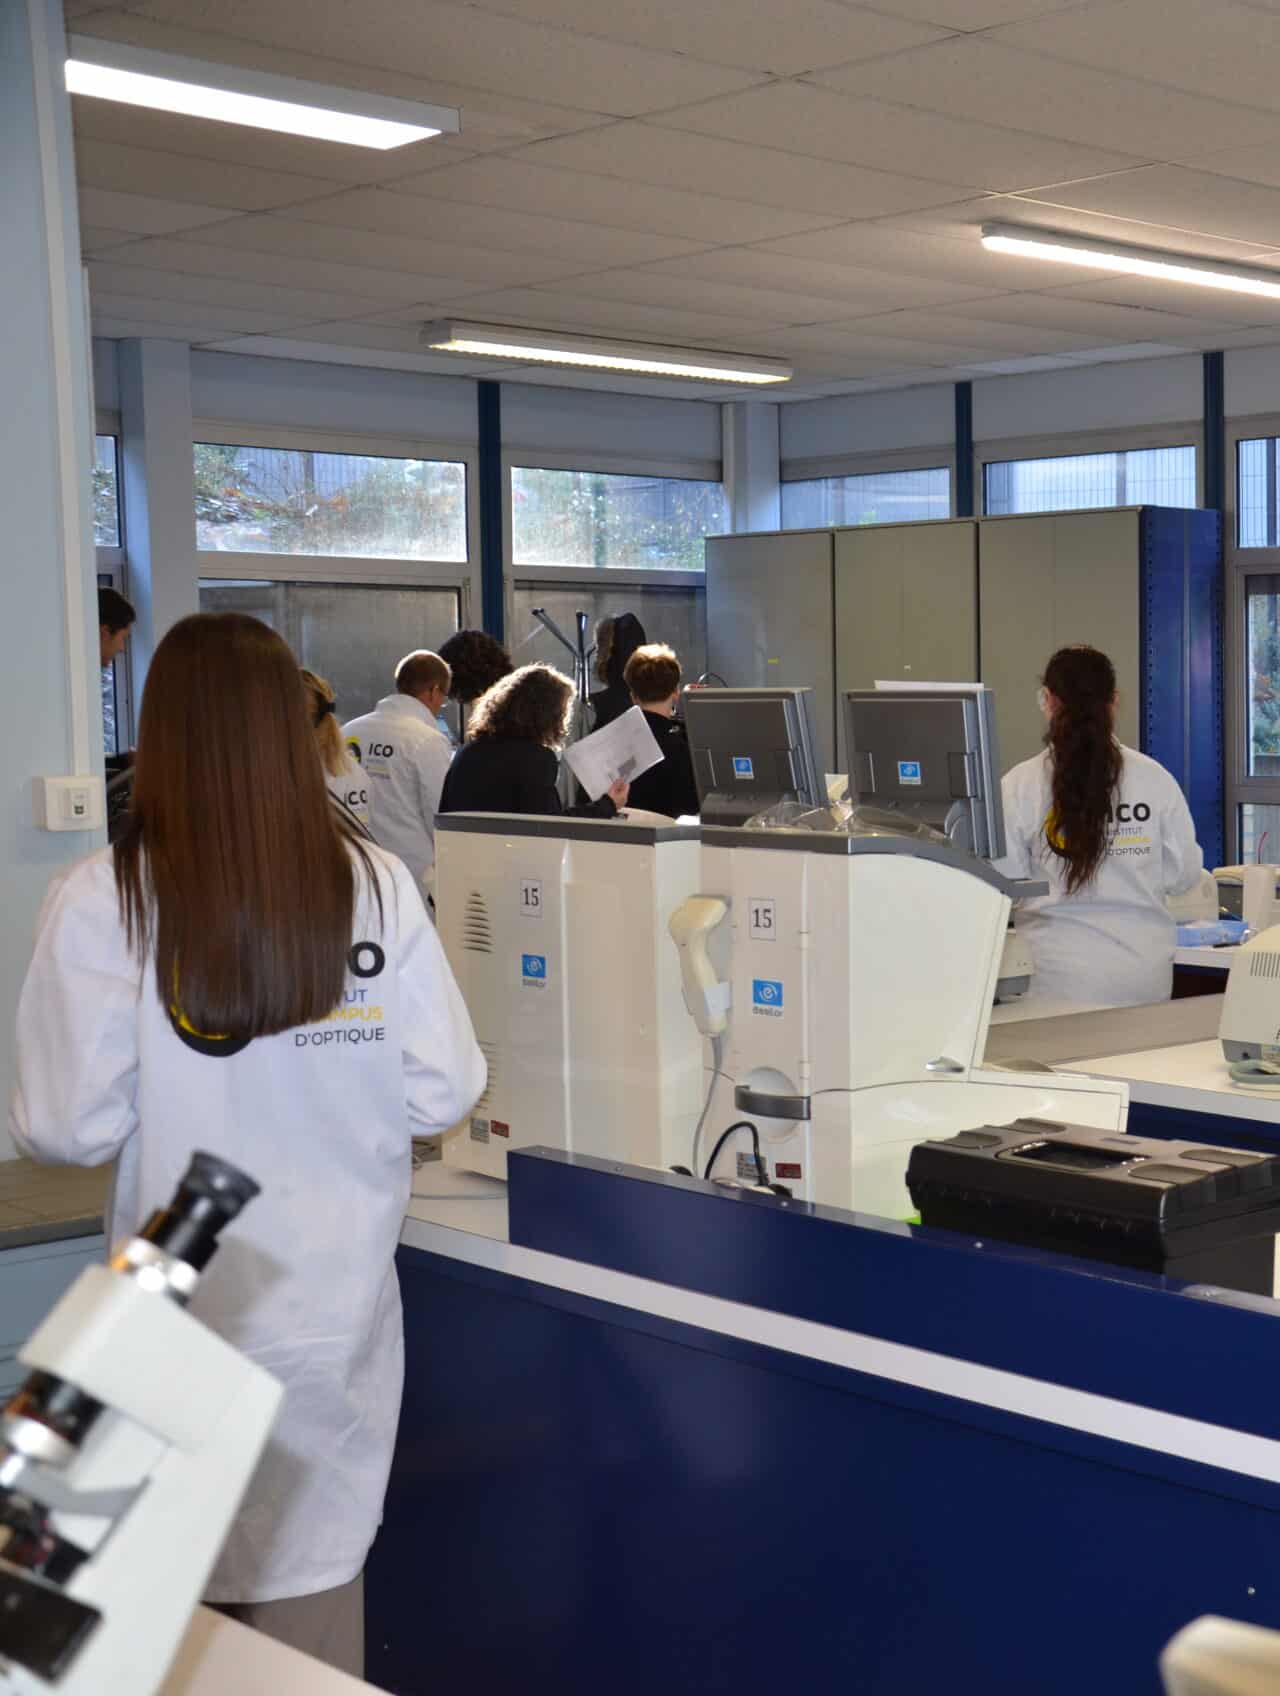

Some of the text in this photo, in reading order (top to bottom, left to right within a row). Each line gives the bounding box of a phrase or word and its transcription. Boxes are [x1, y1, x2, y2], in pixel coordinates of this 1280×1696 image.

[368, 743, 394, 758] ICO
[523, 888, 540, 906] 15
[752, 908, 772, 928] 15
[295, 1026, 385, 1047] D'OPTIQUE
